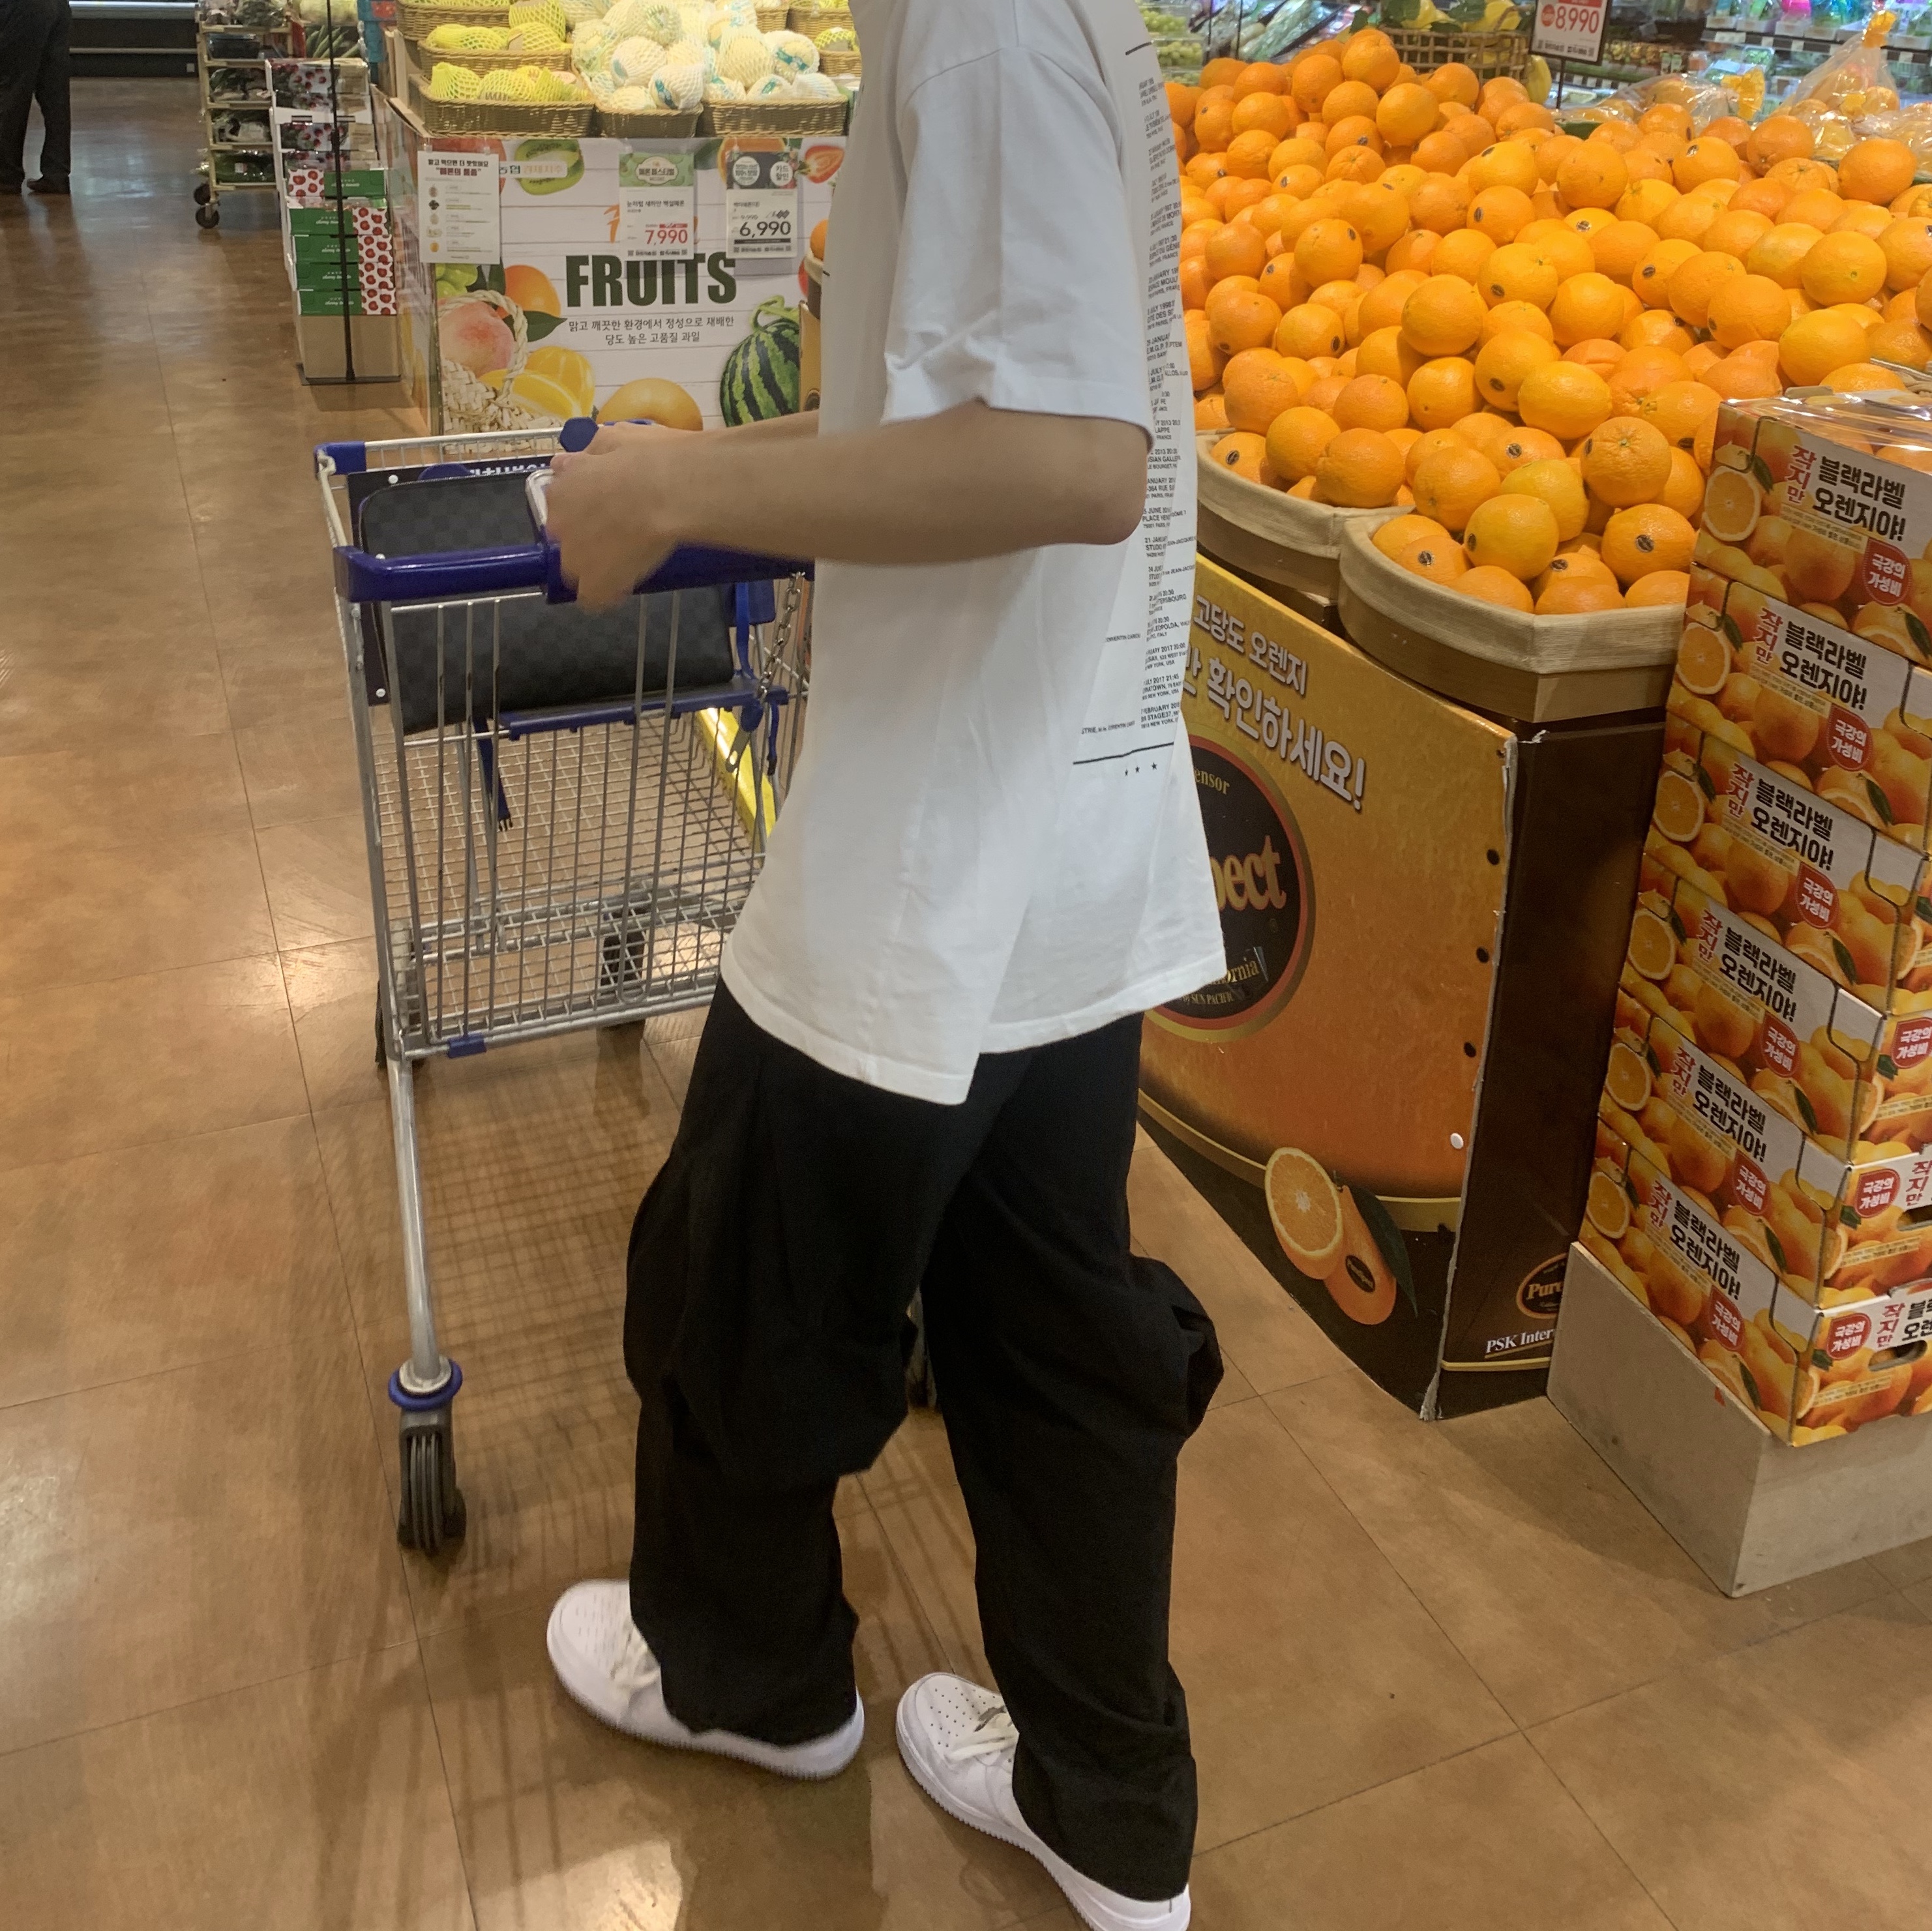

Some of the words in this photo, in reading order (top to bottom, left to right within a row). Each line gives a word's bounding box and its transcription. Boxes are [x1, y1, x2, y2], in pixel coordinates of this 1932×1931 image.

[1556, 6, 1599, 33] 8,990
[645, 229, 688, 246] 7,990
[739, 221, 791, 238] 6,990
[566, 252, 737, 307] FRUITS
[569, 321, 588, 332] 맑고
[591, 319, 621, 331] 깨끗한
[624, 318, 663, 331] 환경에서
[666, 317, 704, 329] 정성으로
[707, 316, 735, 327] 재배한
[605, 334, 625, 346] 당도
[628, 332, 647, 345] 높은
[650, 332, 679, 344] 고품질
[681, 331, 700, 342] 과일
[1785, 445, 1817, 504] 작지만
[1819, 456, 1905, 510] 블랙라벨
[1813, 487, 1906, 541] 오렌지야!
[1872, 553, 1905, 579] 극강의
[1868, 572, 1902, 597] 가성비
[1193, 595, 1245, 653] 고당도
[1249, 632, 1307, 696] 오렌지
[1785, 621, 1866, 680] 블랙라벨
[1779, 651, 1867, 711] 오렌지야!
[1208, 657, 1365, 811] 확인하세요!
[1835, 719, 1867, 747] 극강의
[1831, 736, 1863, 763] 가성비
[1756, 778, 1833, 842] 블랙라벨
[1751, 806, 1834, 871] 오렌지야!
[1804, 877, 1834, 906] 극강의
[1725, 927, 1796, 994] 블랙라벨
[1719, 953, 1796, 1022] 오렌지야!
[1901, 1026, 1932, 1044] 극강의
[1896, 1042, 1928, 1059] 가성비
[1698, 1065, 1766, 1136] 블랙라벨
[1693, 1090, 1767, 1162] 오렌지야!
[1864, 1177, 1895, 1194] 극강의
[1859, 1192, 1891, 1209] 가성비
[1835, 1320, 1866, 1338] 극강의
[1877, 1303, 1905, 1348] 작지만
[1486, 1334, 1517, 1353] PSK
[1831, 1334, 1862, 1353] 가성비
